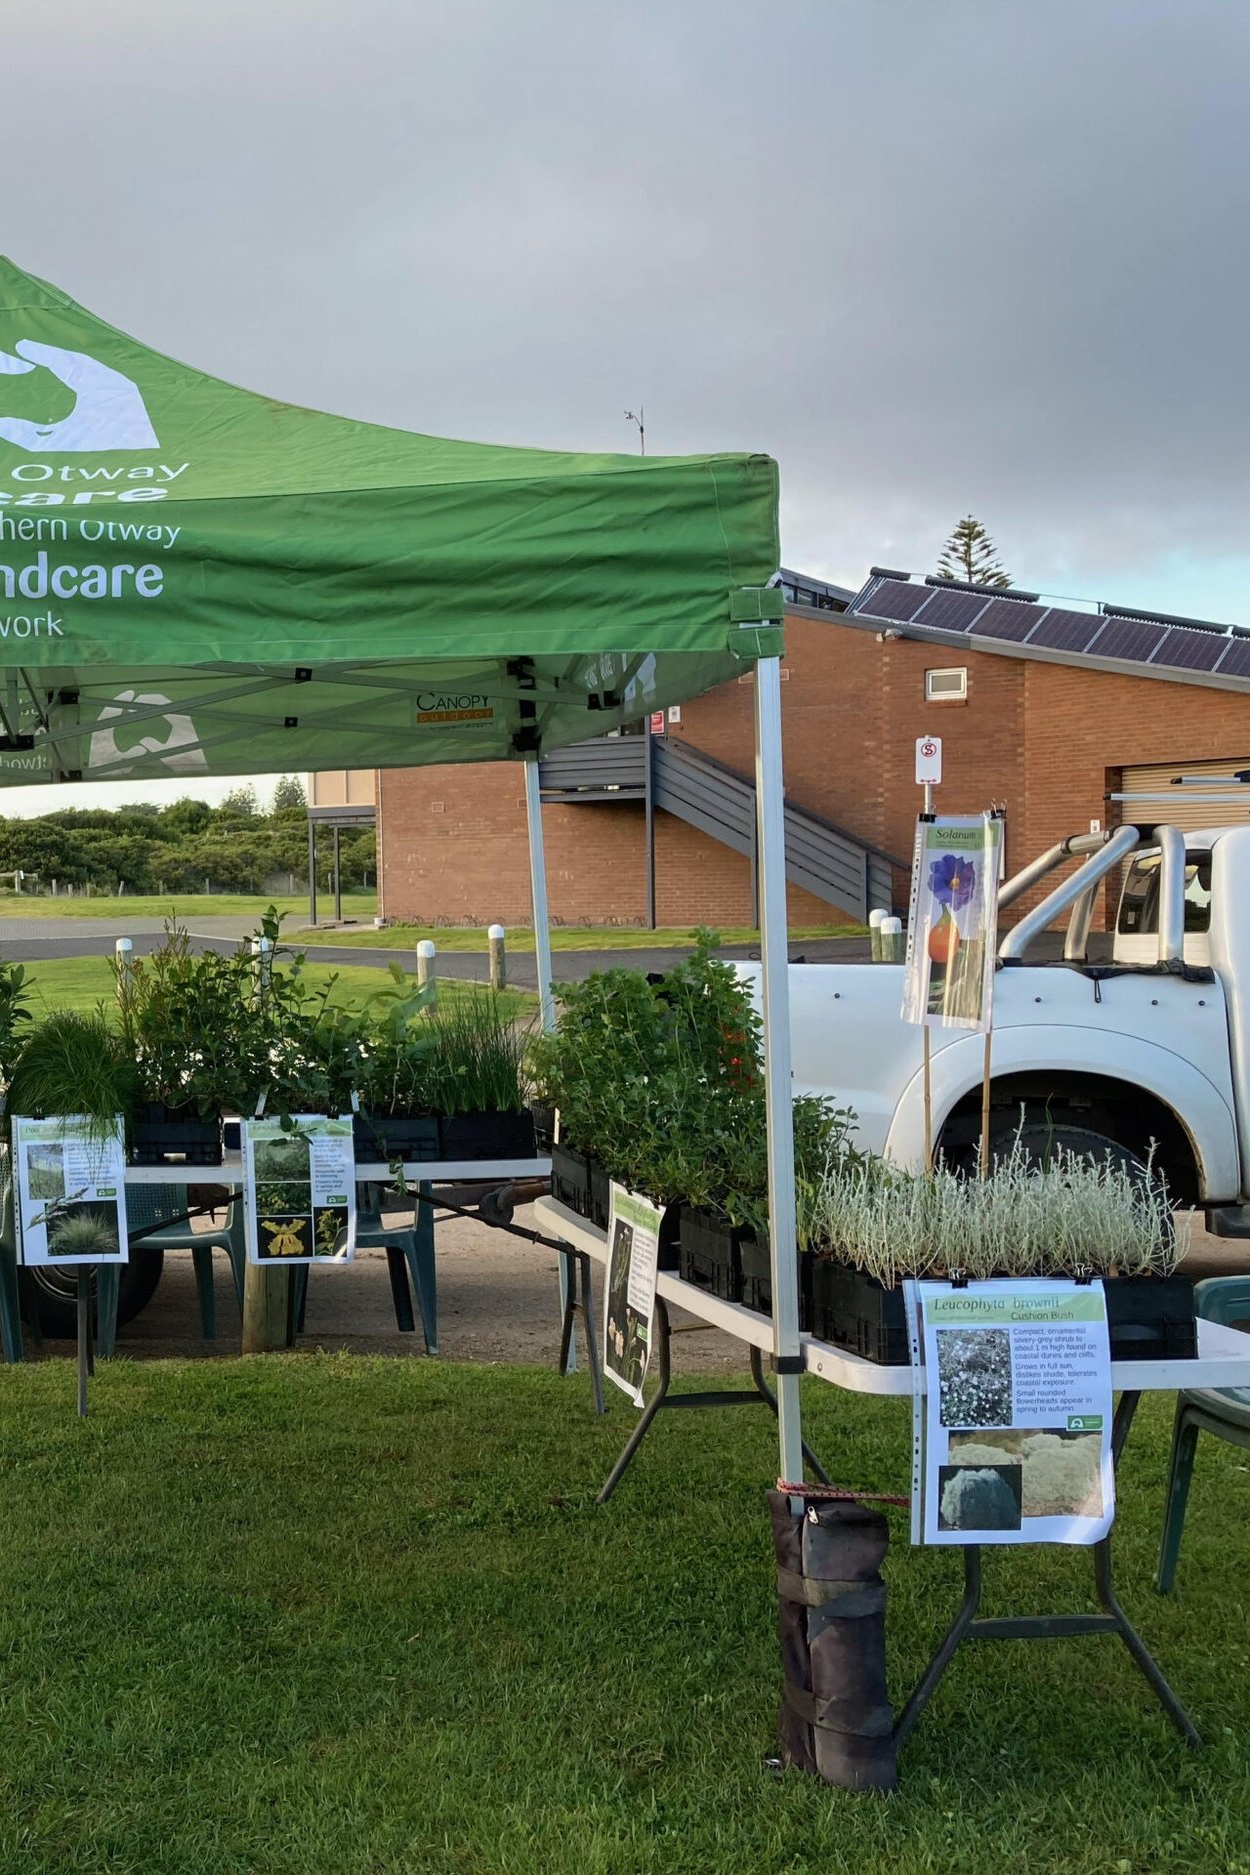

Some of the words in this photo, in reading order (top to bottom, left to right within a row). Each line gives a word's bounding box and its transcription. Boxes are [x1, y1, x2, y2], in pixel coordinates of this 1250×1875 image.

[11, 462, 190, 482] Otway
[79, 519, 181, 549] Otway
[416, 692, 489, 711] CANOPY
[936, 829, 977, 839] Solanum
[934, 1297, 1005, 1312] Leucophyta
[1011, 1312, 1048, 1321] Cushion
[1051, 1311, 1074, 1320] Bush
[1048, 1327, 1086, 1335] ornamental
[1055, 1335, 1075, 1343] shrub
[1050, 1344, 1065, 1352] high
[1016, 1389, 1036, 1397] Small
